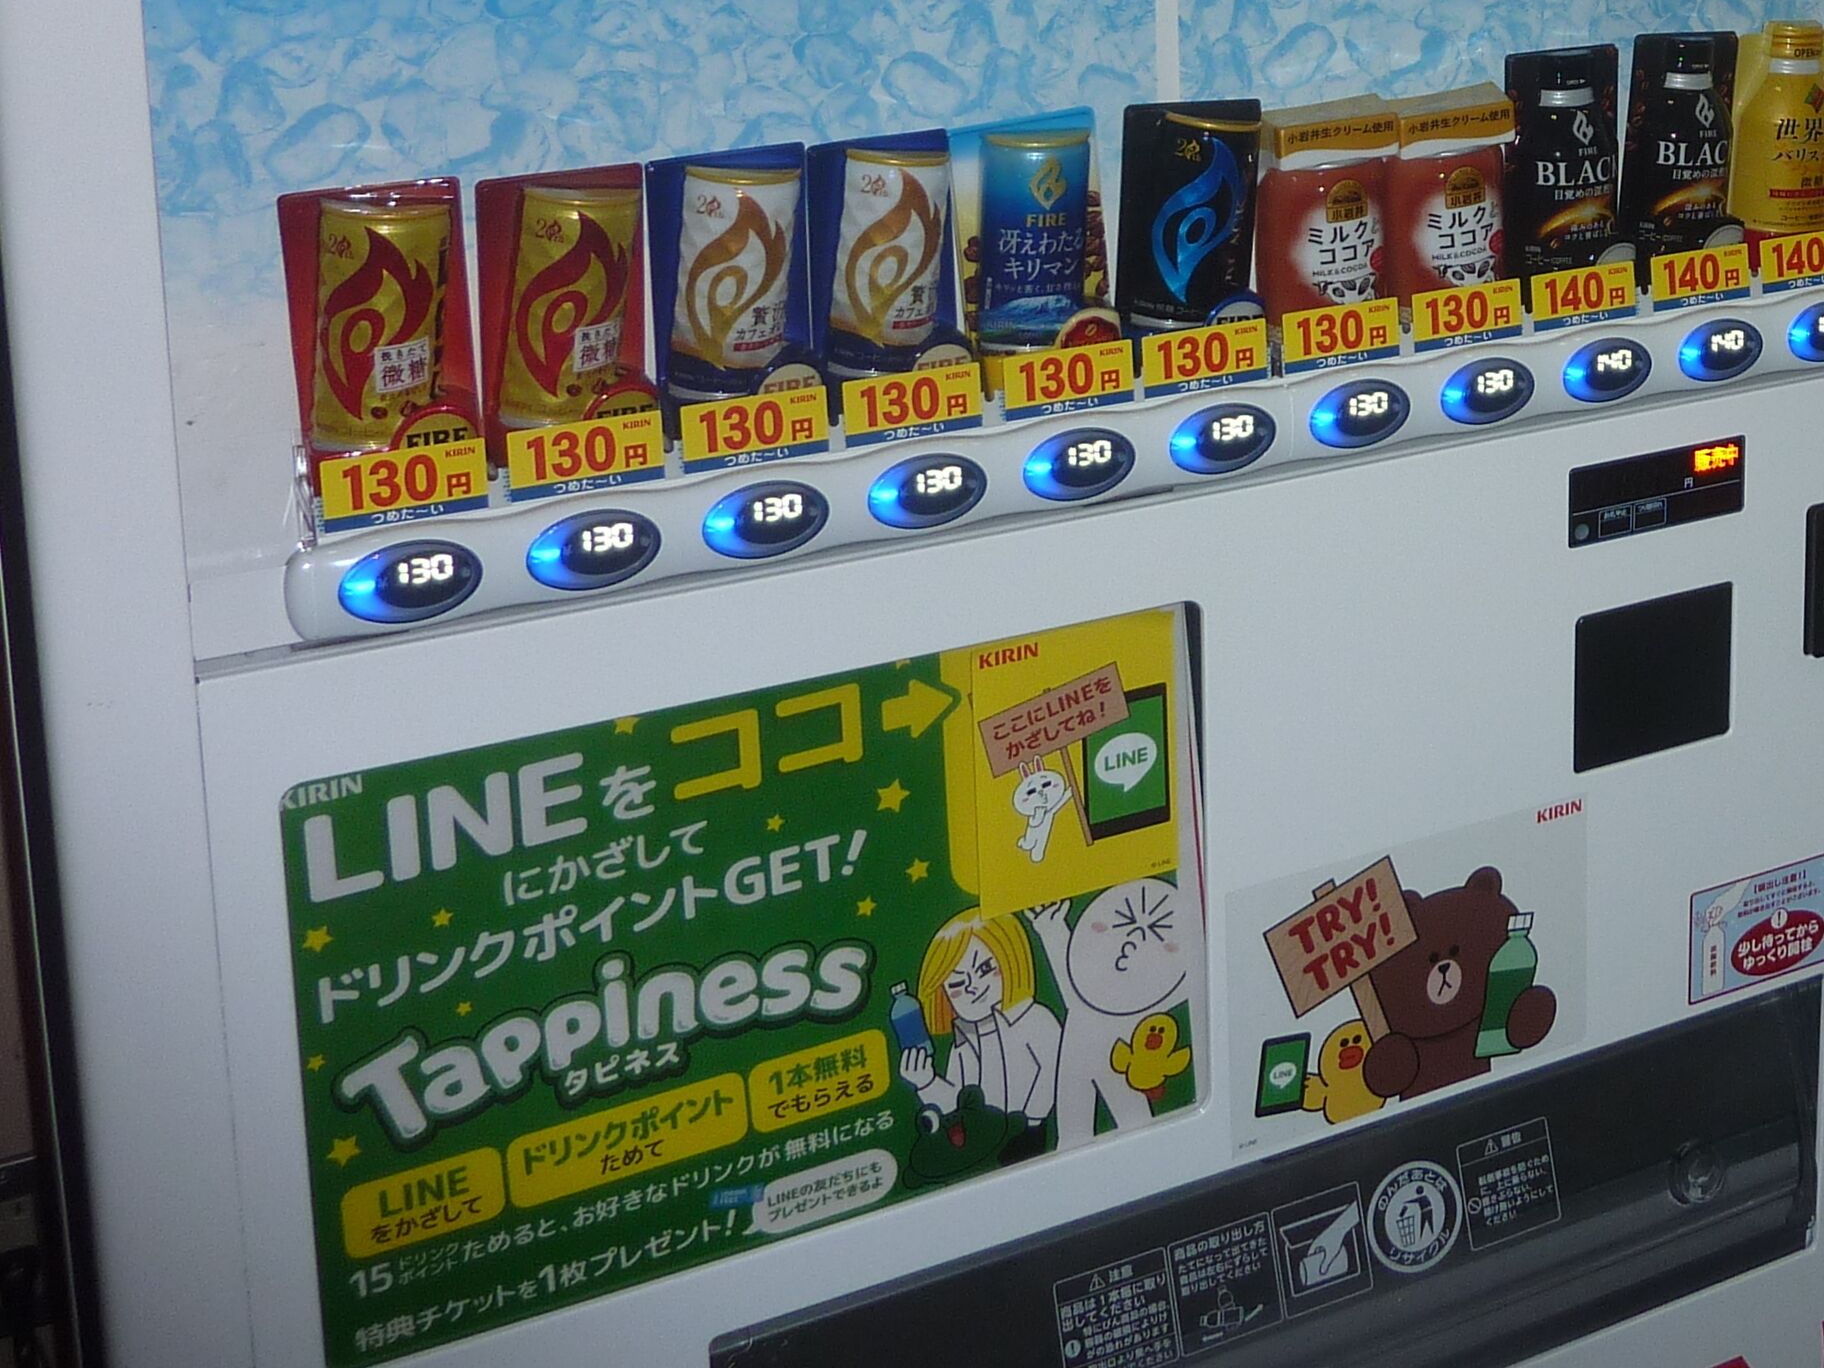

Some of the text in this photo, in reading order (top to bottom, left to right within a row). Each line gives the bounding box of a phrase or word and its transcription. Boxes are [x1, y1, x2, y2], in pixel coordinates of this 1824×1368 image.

[1287, 119, 1395, 145] 小岩井生クリーム使用
[1775, 117, 1824, 145] 世界
[1026, 212, 1067, 228] FIRE
[1003, 257, 1080, 282] キリマン
[1319, 238, 1375, 266] ココア
[1711, 330, 1744, 352] 140
[1349, 391, 1388, 417] 130
[621, 419, 653, 432] KIRIN
[444, 445, 476, 458] KIRIN
[916, 466, 962, 494] 130
[398, 554, 454, 584] 130
[977, 641, 1040, 670] KIRIN
[990, 675, 1113, 741] ここにLINEを
[1004, 701, 1108, 762] かざしてね!
[1103, 745, 1149, 774] LINE
[1535, 798, 1583, 824] KIRIN
[502, 820, 708, 906] にかざして
[1288, 877, 1379, 955] TRY!
[1302, 913, 1394, 993] TRY!
[1737, 919, 1820, 958] 少し待ってから
[339, 946, 868, 1144] Tappiness
[564, 1044, 682, 1098] タピネス
[767, 1042, 868, 1097] 1本無料
[1272, 1067, 1294, 1085] LINE
[767, 1074, 875, 1117] でもらえる
[521, 1086, 734, 1176] ドリンクポイント
[599, 1140, 665, 1176] ためて
[378, 1165, 470, 1220] LINE
[767, 1160, 883, 1208] LINEの友だちにも
[767, 1176, 884, 1224] プレゼントできるよ
[1377, 1168, 1449, 1212] のんだあとは
[369, 1193, 483, 1245] をかざして
[1173, 1219, 1266, 1261] 商品の取り出し方
[1388, 1228, 1450, 1264] リサイクル
[349, 1262, 394, 1299] 15
[354, 1207, 738, 1353] 特典チケットを1枚プレゼント!
[1107, 1264, 1135, 1284] 注意
